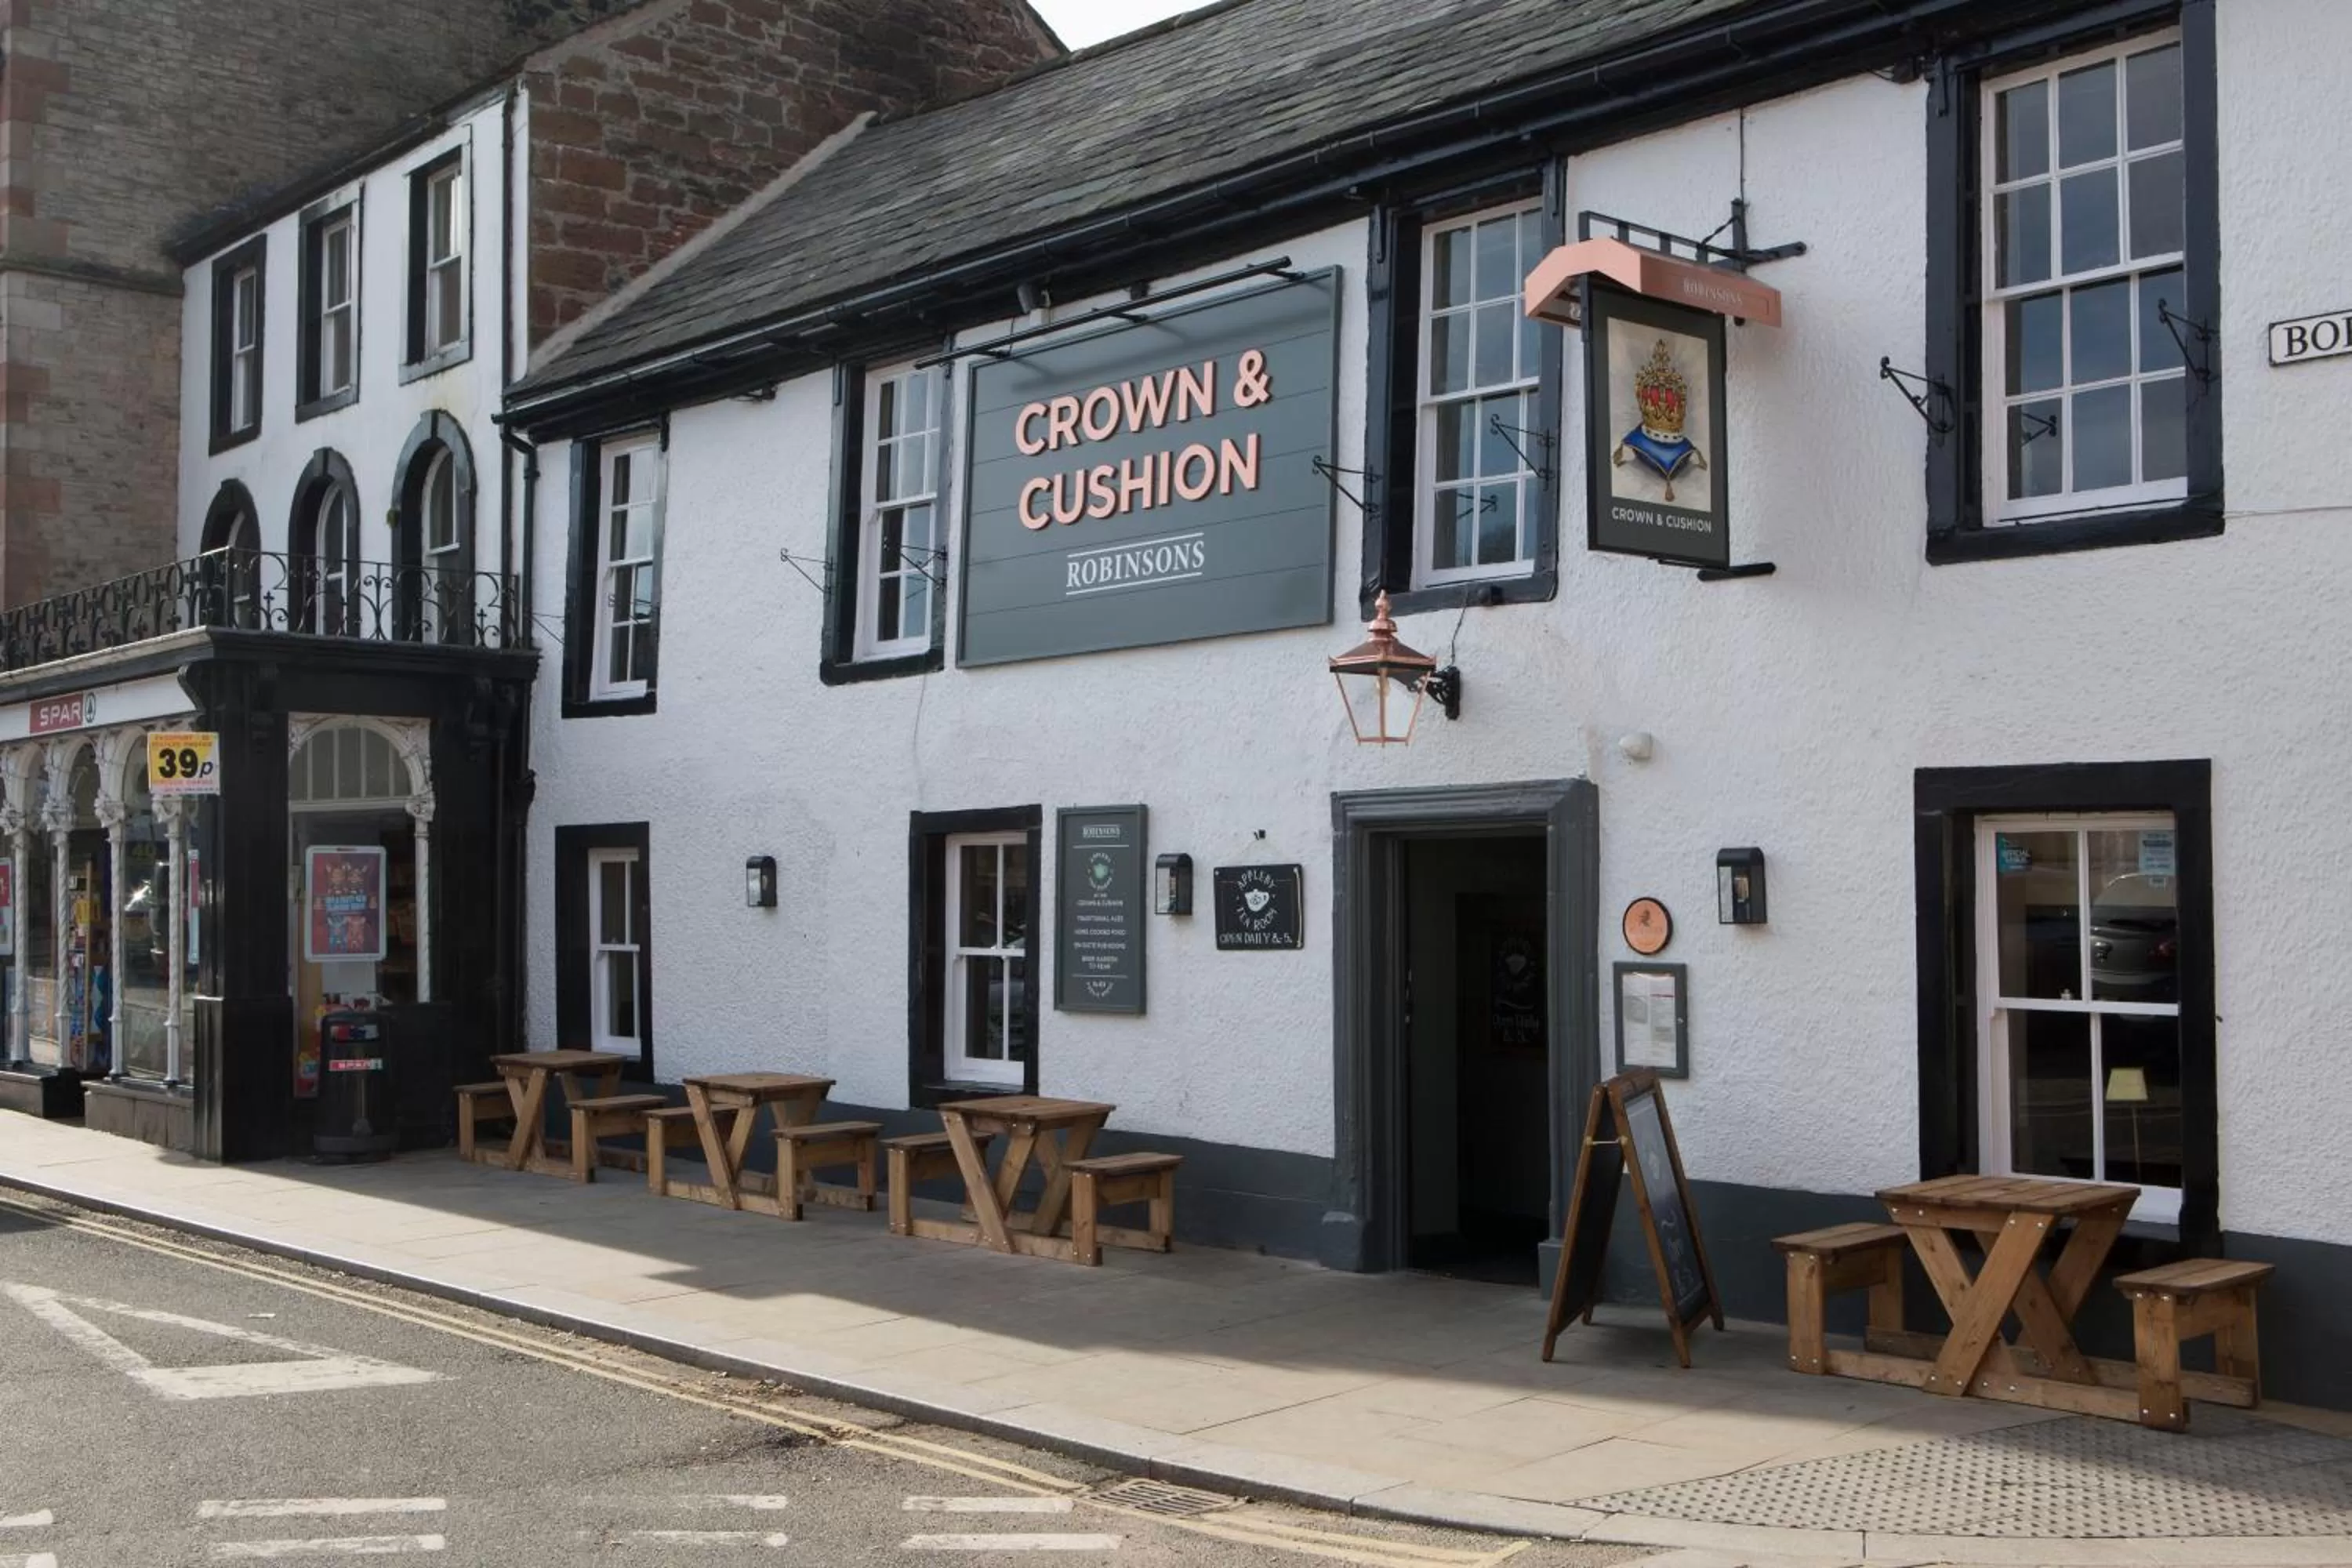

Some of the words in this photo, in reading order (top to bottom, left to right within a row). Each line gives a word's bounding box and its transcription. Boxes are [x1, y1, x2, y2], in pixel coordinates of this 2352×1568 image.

[1014, 360, 1216, 456] CROWN
[1233, 350, 1272, 408] &
[1019, 433, 1261, 530] CUSHION
[1611, 506, 1653, 525] CROWN
[1656, 514, 1664, 527] &
[1666, 514, 1711, 533] CUSHION
[1066, 540, 1205, 588] ROBINSONS
[40, 702, 82, 727] SPAR
[1236, 869, 1277, 891] APPLEBY
[1254, 907, 1278, 931] ROOM
[1244, 932, 1271, 944] DAILY
